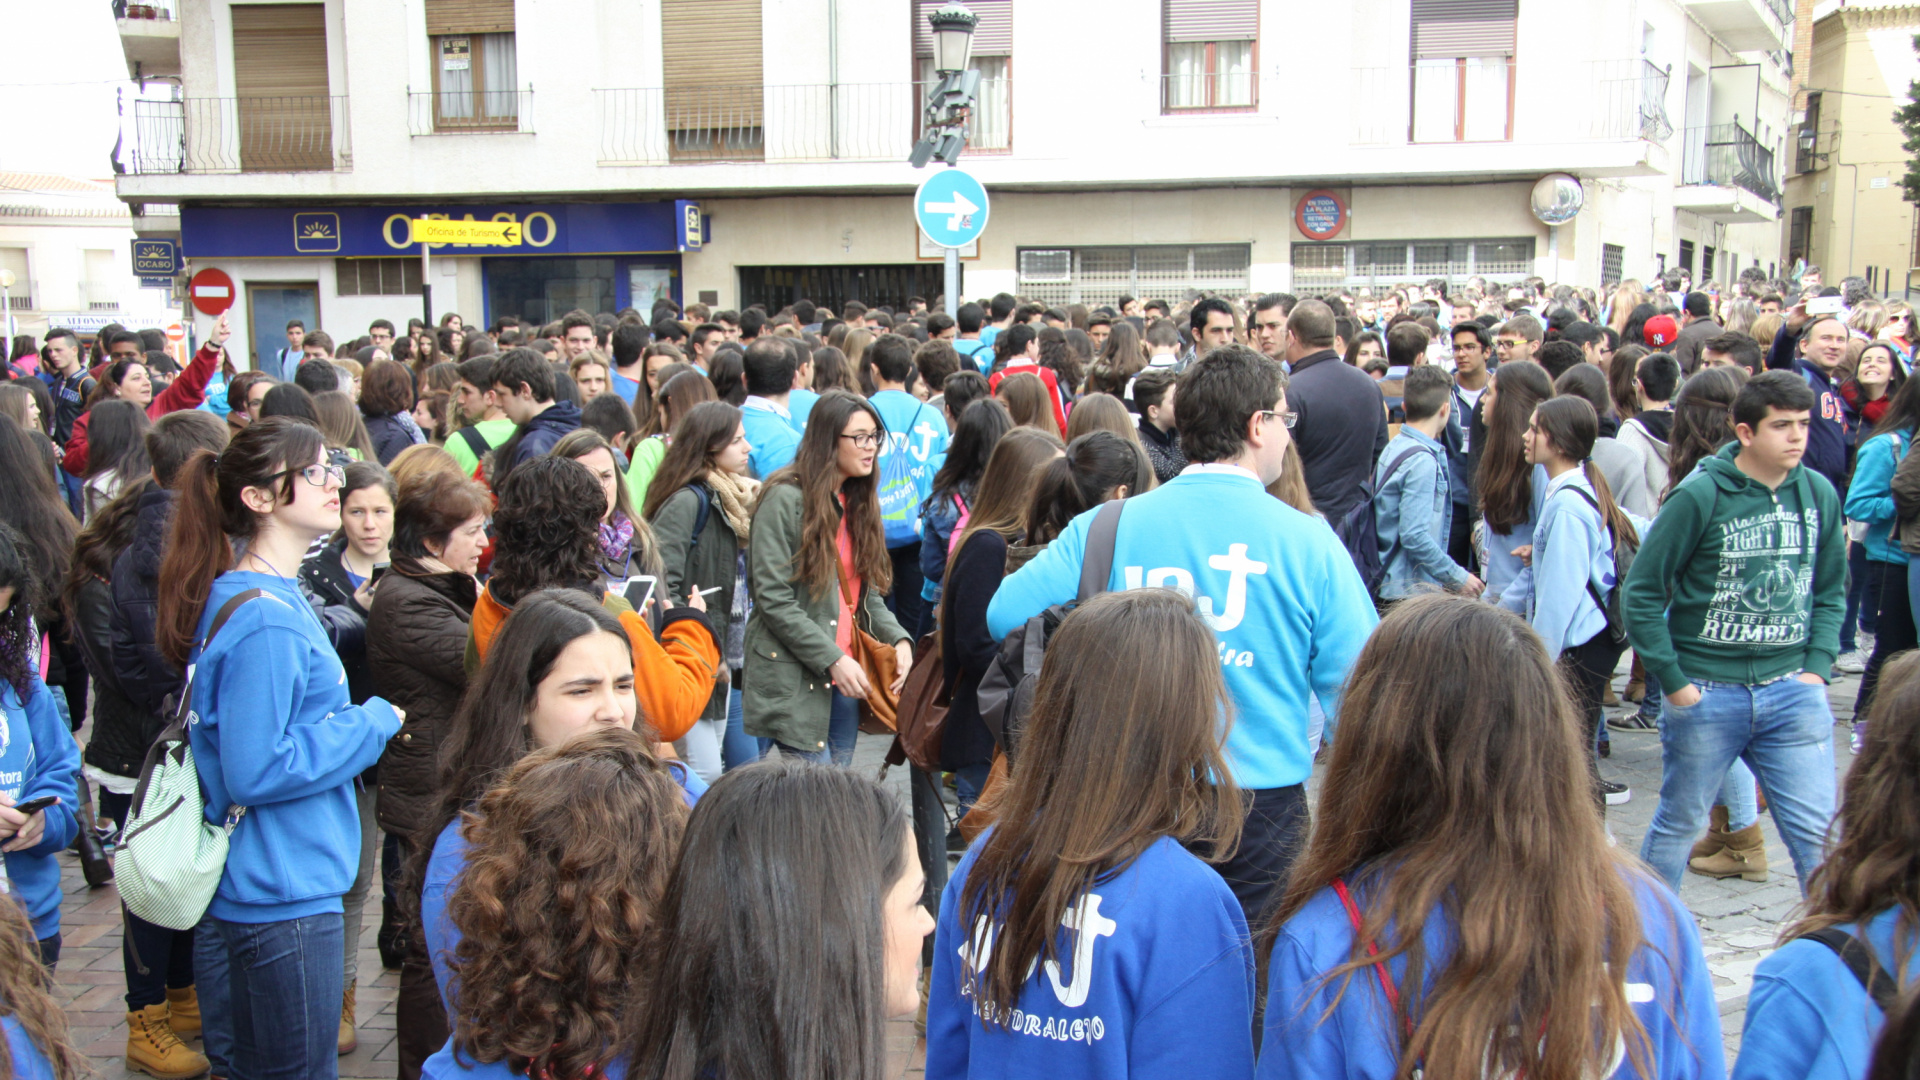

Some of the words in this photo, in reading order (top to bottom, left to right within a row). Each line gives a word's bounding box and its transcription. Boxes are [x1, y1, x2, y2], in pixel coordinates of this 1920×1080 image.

[427, 226, 454, 237] Oficina
[456, 228, 467, 237] de
[470, 228, 500, 238] Turismo
[138, 260, 171, 269] OCASO
[1722, 522, 1776, 552] FIGHT
[1714, 581, 1743, 590] OVER
[1706, 609, 1736, 623] LETS
[1741, 615, 1764, 624] GET
